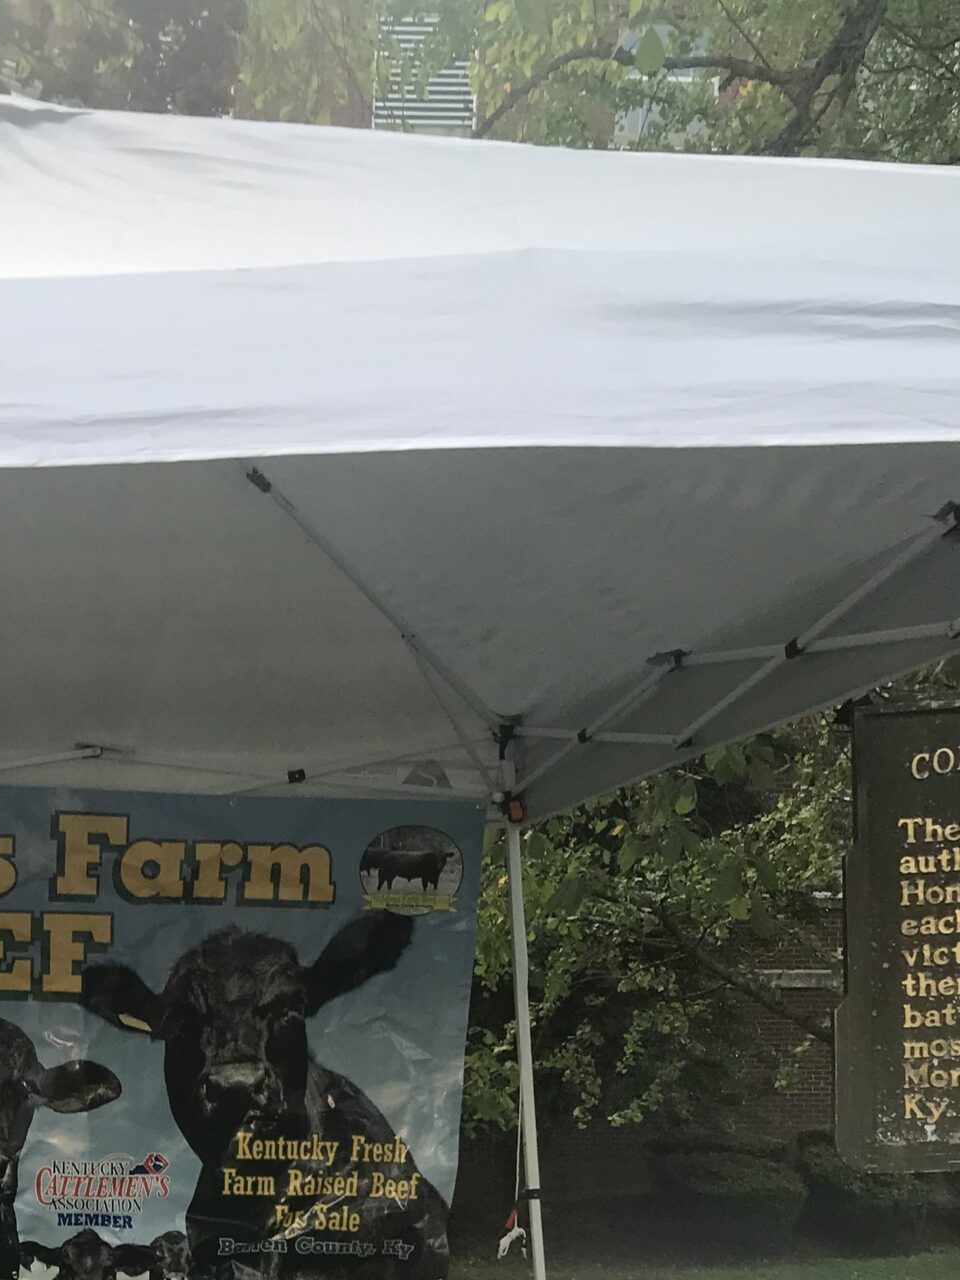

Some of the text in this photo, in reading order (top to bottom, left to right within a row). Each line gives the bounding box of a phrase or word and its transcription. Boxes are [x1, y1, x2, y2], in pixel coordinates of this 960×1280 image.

[911, 747, 960, 779] CO
[52, 811, 335, 907] Farm
[901, 972, 960, 997] the
[236, 1132, 408, 1166] Kentucky Fresh
[52, 1160, 128, 1175] KENTUCKY
[35, 1165, 170, 1206] CATTLEMEN'S
[222, 1168, 421, 1200] Farm Raised Beef
[49, 1199, 143, 1213] ASSOCIATION
[57, 1212, 134, 1229] MEMBER
[314, 1203, 361, 1232] Sale
